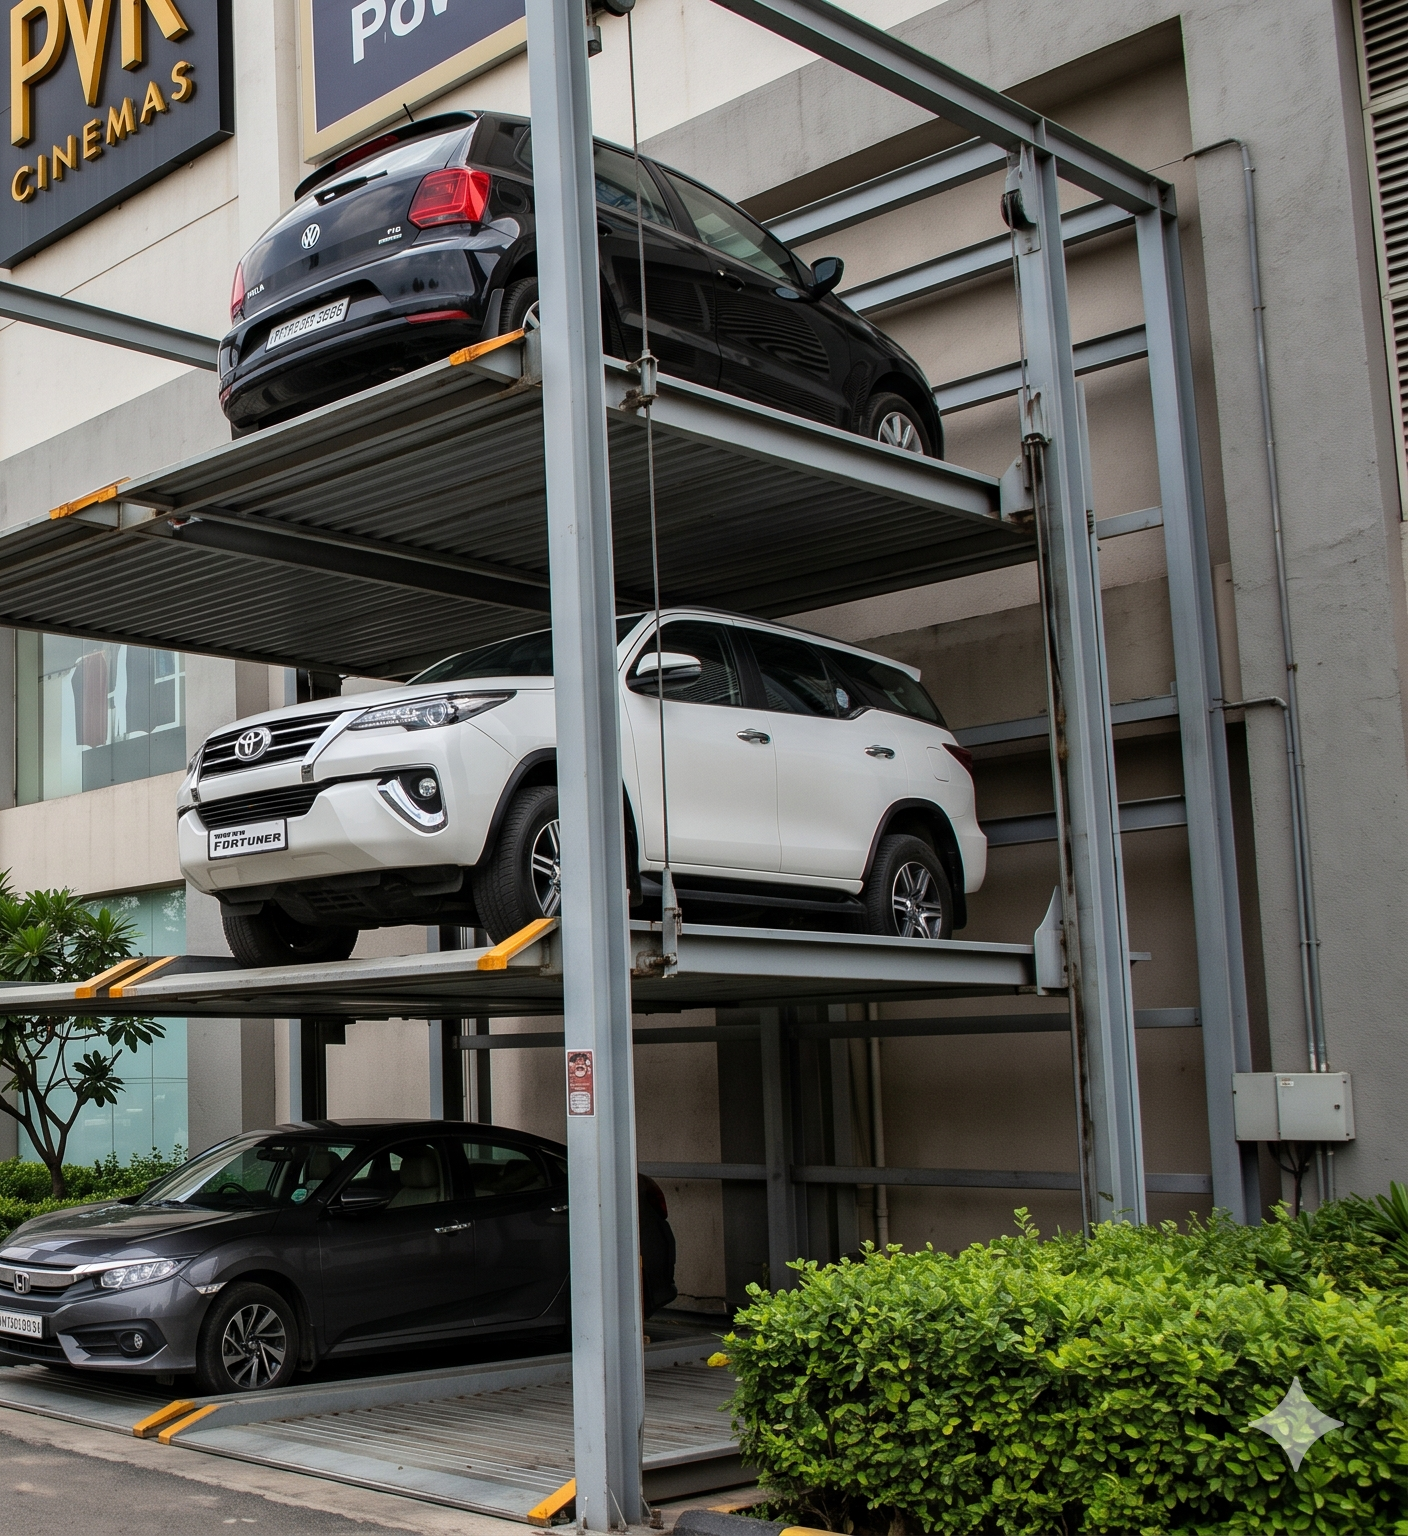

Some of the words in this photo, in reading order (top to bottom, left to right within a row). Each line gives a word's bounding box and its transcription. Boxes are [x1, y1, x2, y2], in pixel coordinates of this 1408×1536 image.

[351, 0, 448, 65] Po
[11, 60, 194, 203] CINEMAS
[214, 832, 282, 852] FORTUNER
